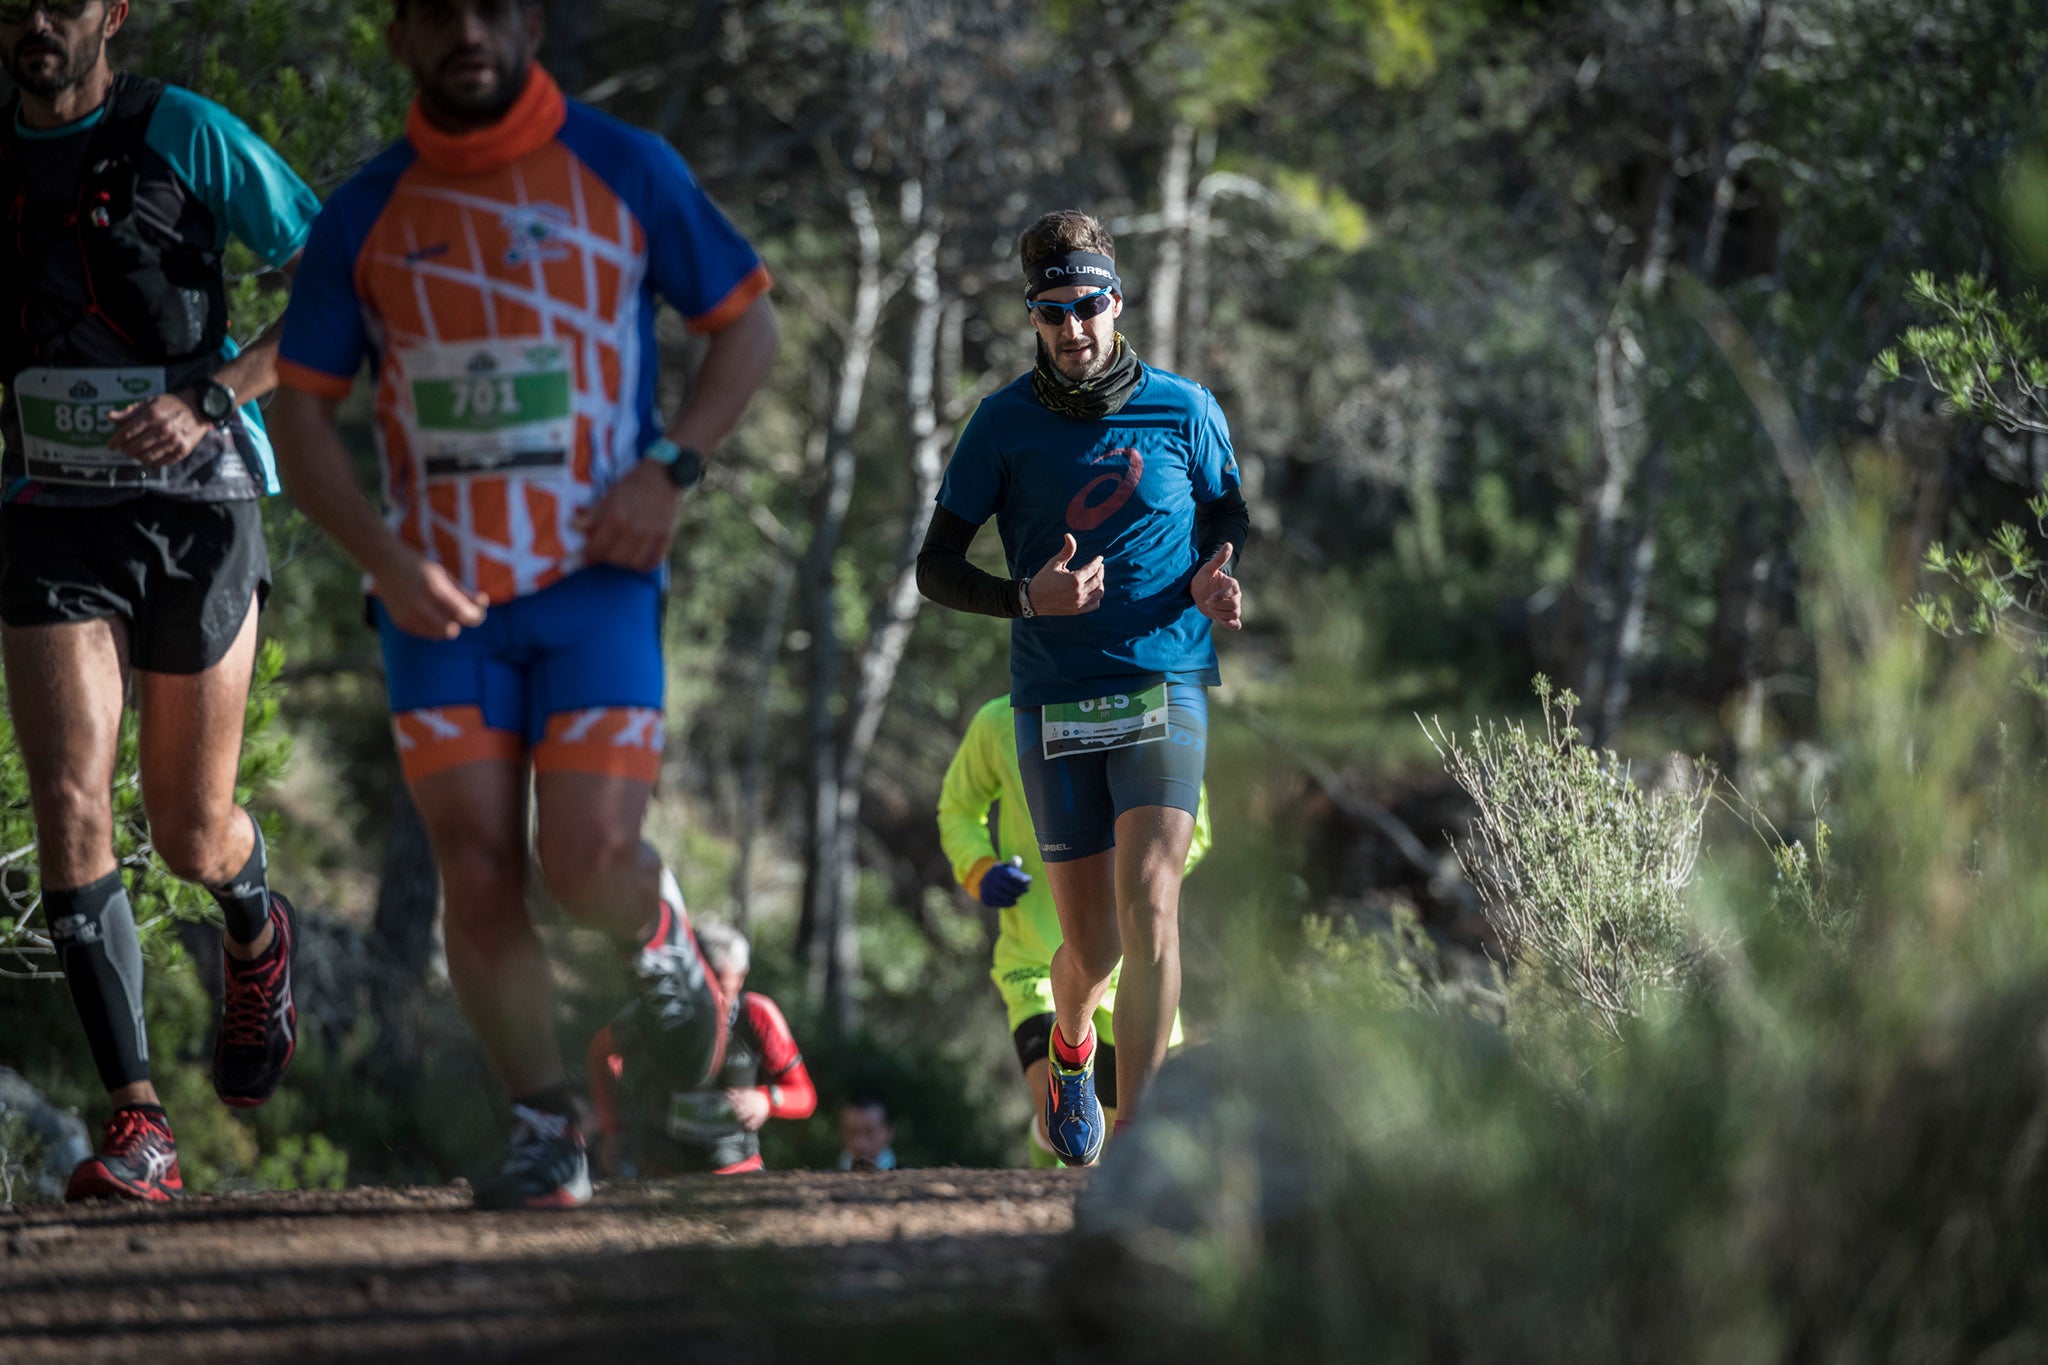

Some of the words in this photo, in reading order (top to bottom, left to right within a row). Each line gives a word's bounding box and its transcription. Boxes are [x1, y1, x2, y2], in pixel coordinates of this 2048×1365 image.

[1065, 266, 1113, 280] LURBEL
[451, 379, 523, 418] 701
[54, 403, 116, 433] 865
